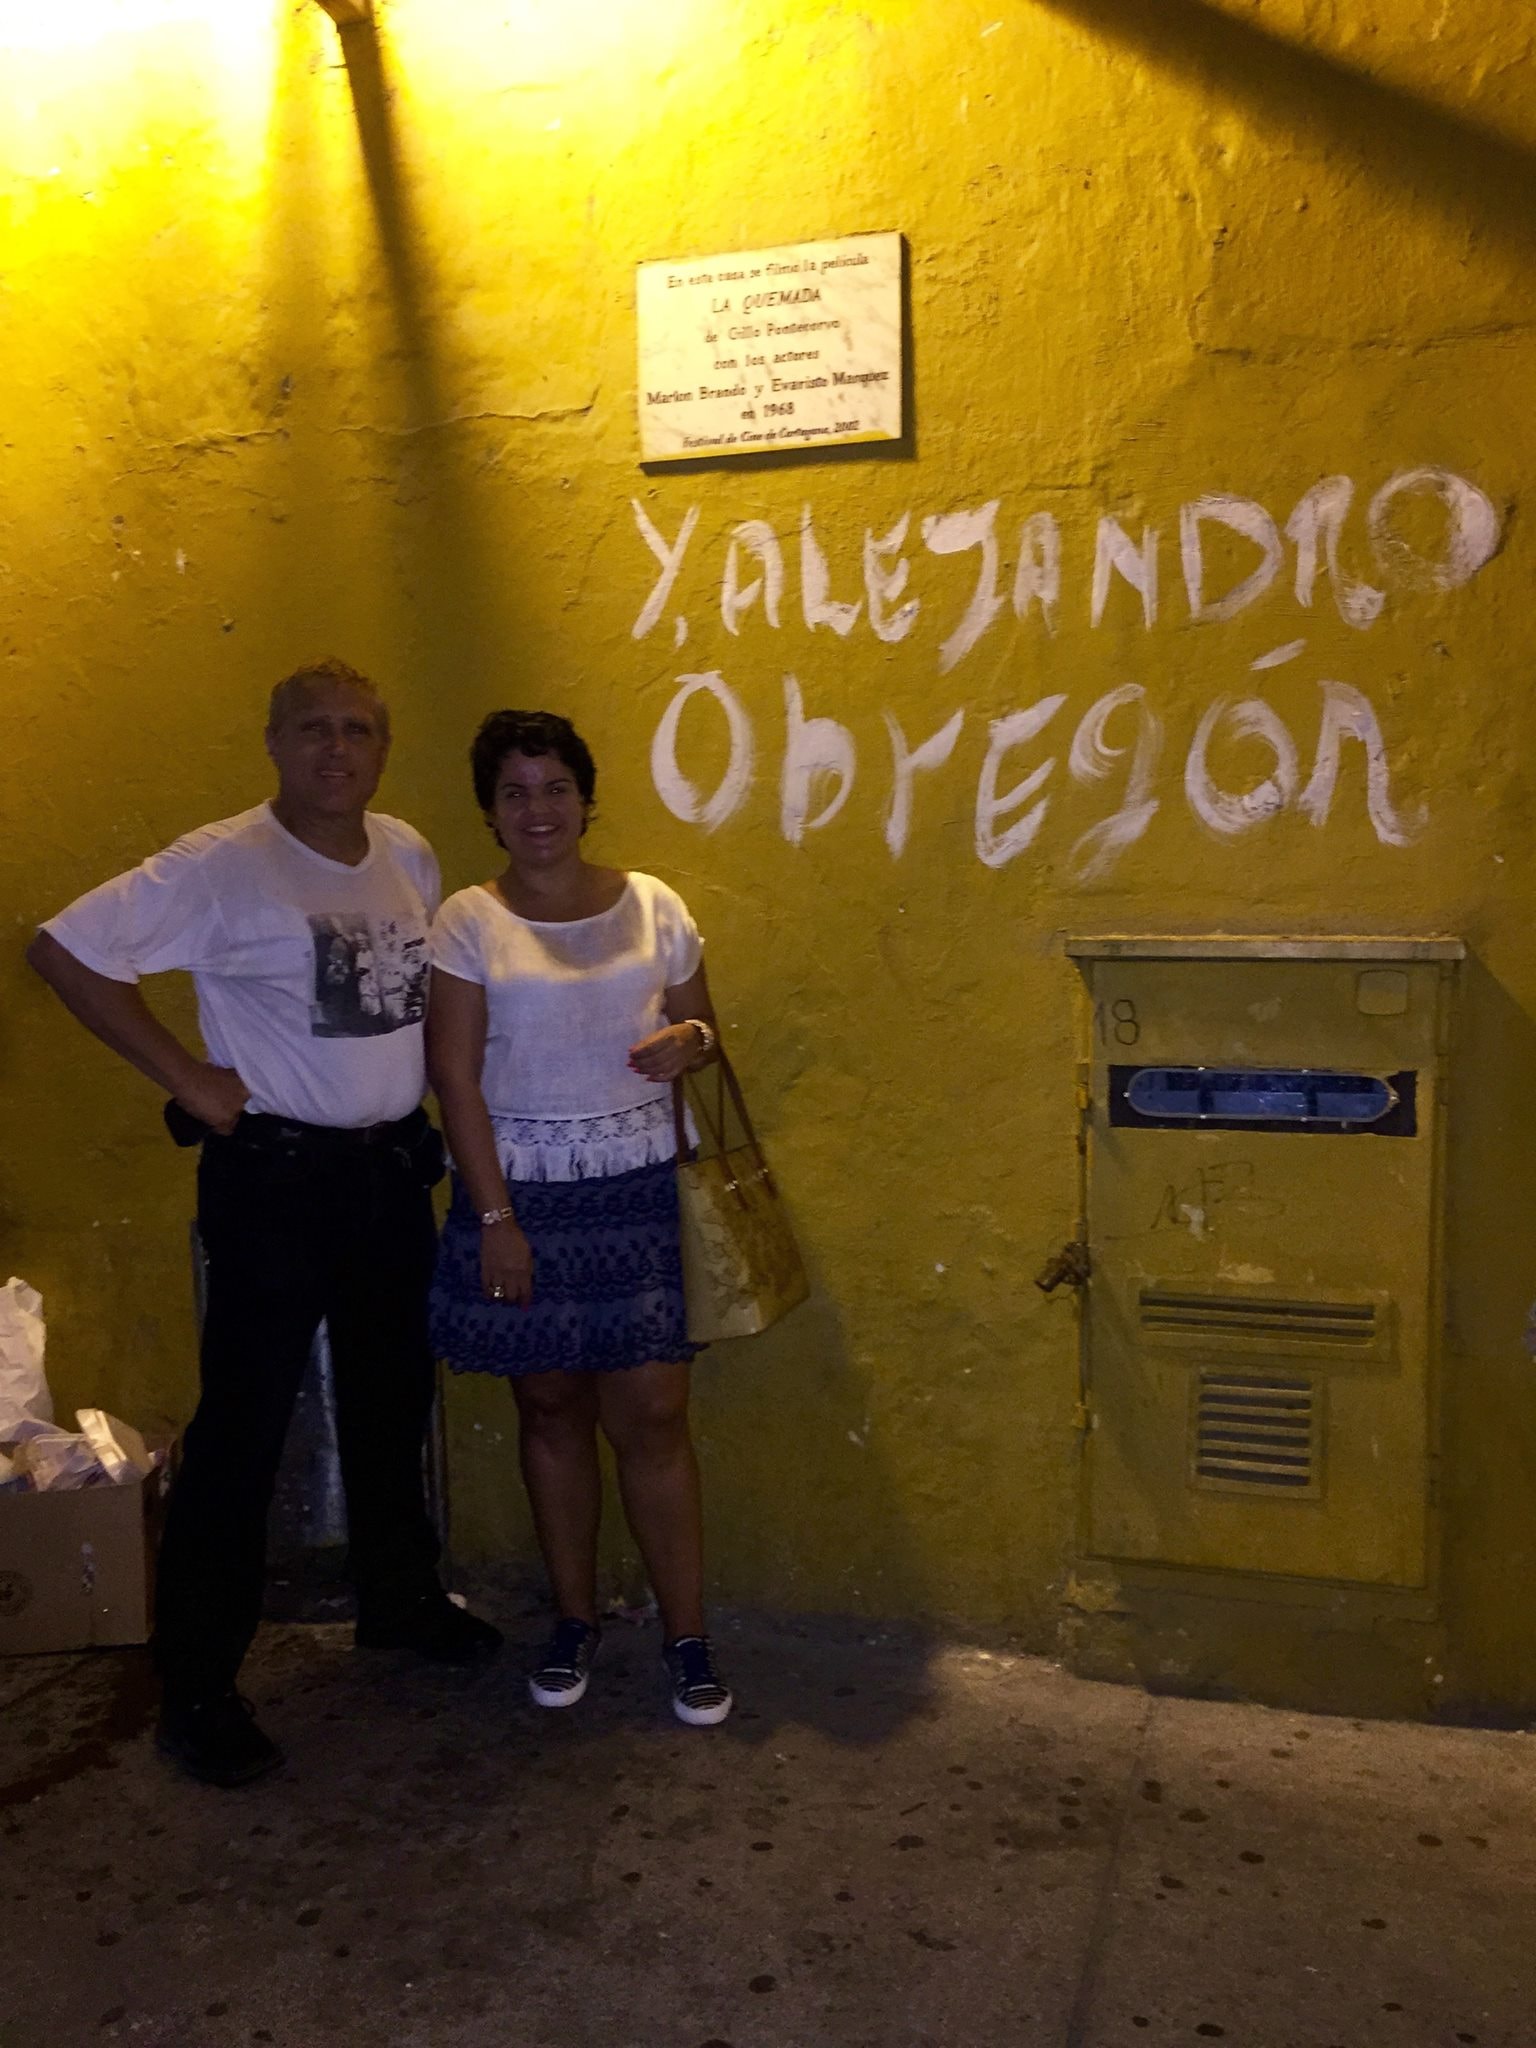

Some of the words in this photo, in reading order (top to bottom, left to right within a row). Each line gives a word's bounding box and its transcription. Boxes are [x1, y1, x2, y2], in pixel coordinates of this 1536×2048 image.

[667, 275, 683, 288] En
[689, 271, 713, 284] este
[718, 270, 745, 282] casa
[749, 268, 761, 279] se
[803, 258, 816, 272] la
[712, 298, 731, 314] LA
[743, 288, 822, 315] QUEMADA
[704, 328, 718, 343] de
[728, 325, 761, 341] Gillo
[767, 319, 841, 337] Pontecorvo
[745, 354, 765, 366] los
[773, 349, 820, 364] actores
[646, 390, 694, 405] Marlon
[699, 384, 747, 400] Brando
[754, 382, 765, 398] y
[771, 377, 828, 393] Evaristo
[740, 408, 756, 420] en
[763, 401, 795, 417] 1968
[723, 432, 738, 444] de
[740, 430, 762, 443] Cine
[763, 428, 777, 441] de
[720, 467, 1500, 674] ALEJANDRO
[1095, 998, 1141, 1047] 18
